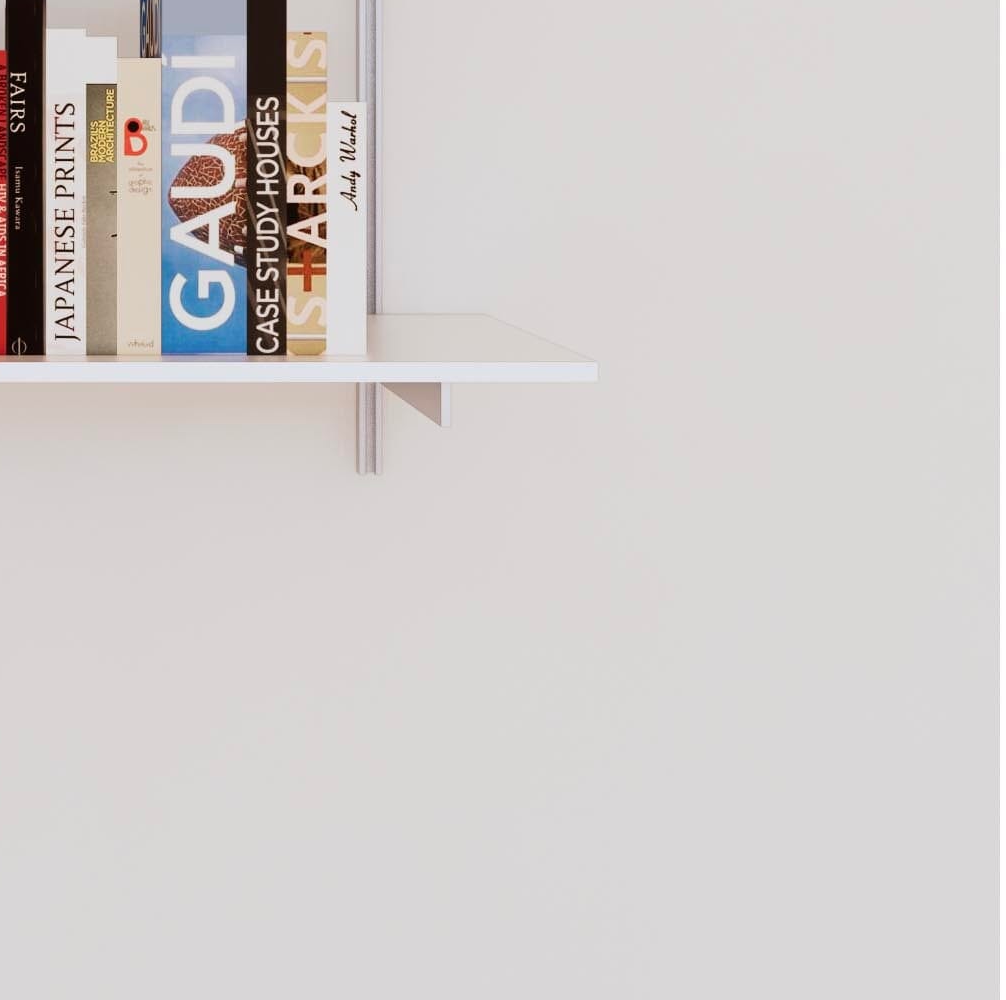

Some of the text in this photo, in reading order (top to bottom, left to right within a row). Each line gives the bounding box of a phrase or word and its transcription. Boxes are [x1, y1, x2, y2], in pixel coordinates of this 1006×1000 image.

[9, 72, 26, 133] FAIRS
[98, 119, 107, 163] MODERN
[105, 89, 115, 163] ARCHITECTURE
[14, 166, 24, 230] Isamu Kawara
[162, 53, 236, 331] GAUDÍ
[339, 110, 361, 212] Andy Warhol
[54, 102, 80, 341] JAPANESE PRINTS
[256, 96, 280, 355] CASE STUDY HOUSES
